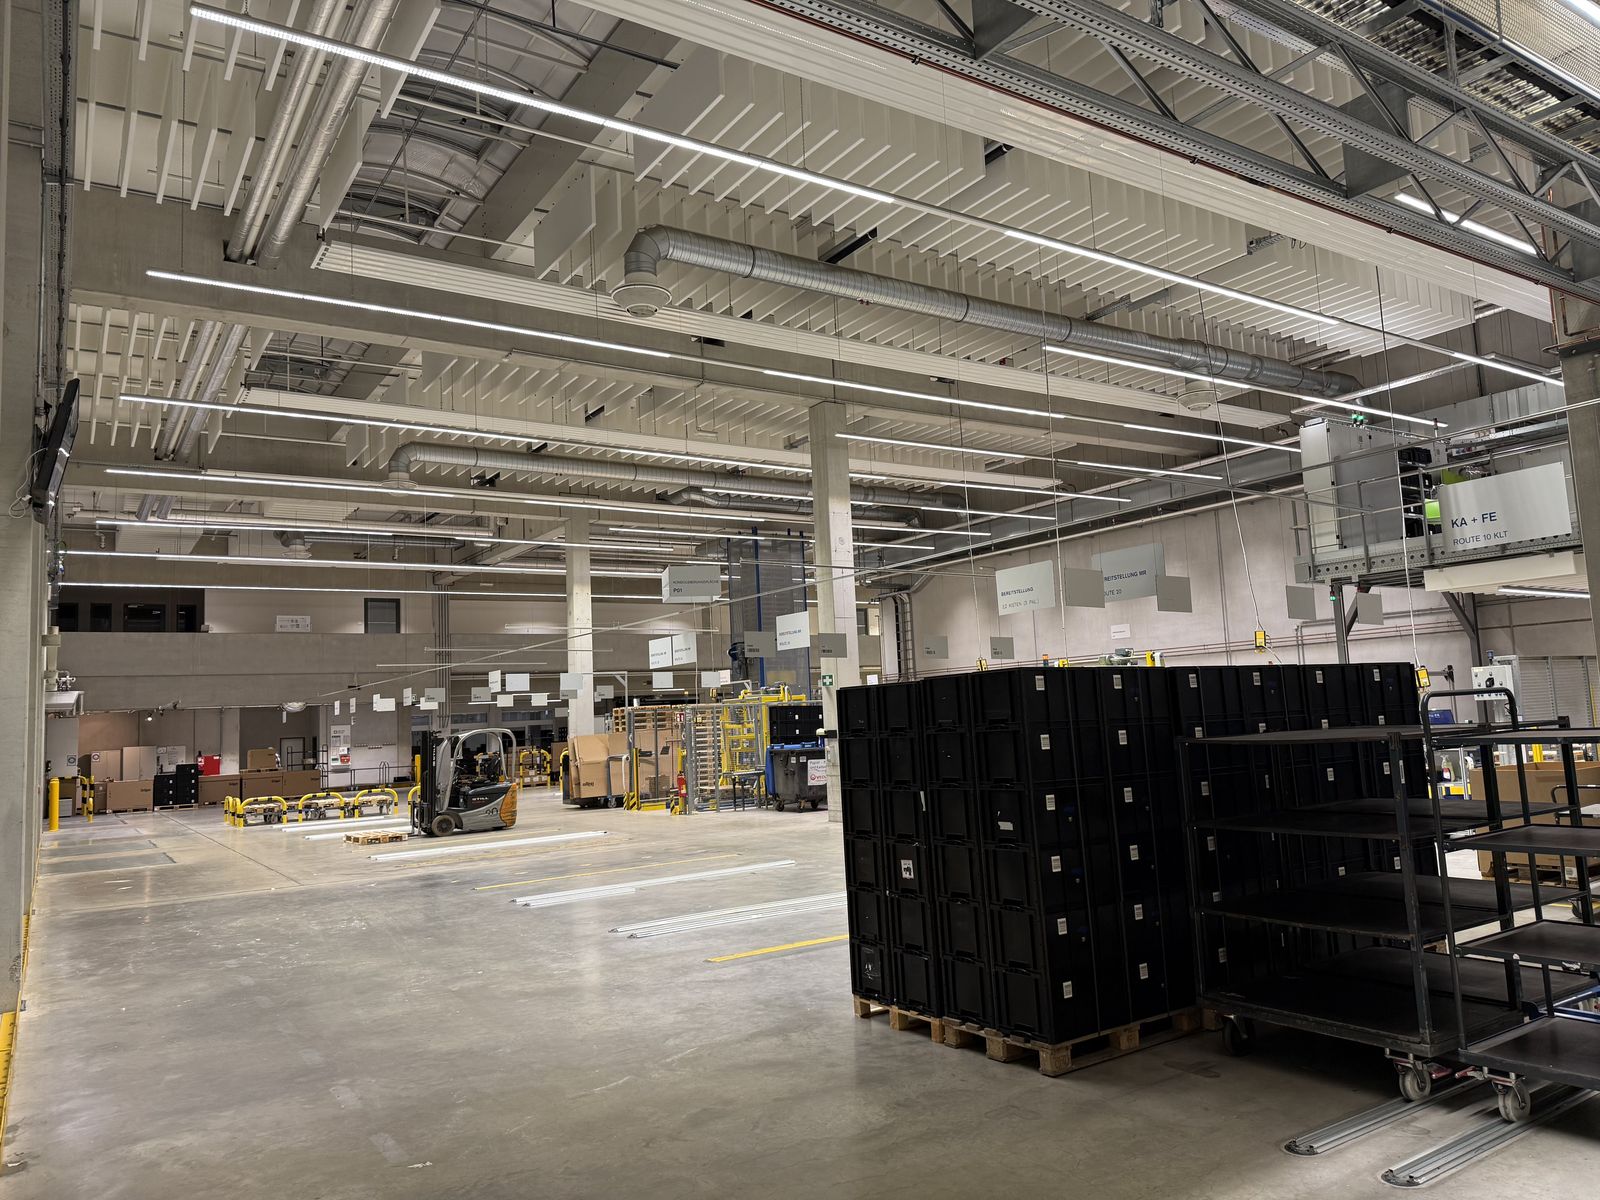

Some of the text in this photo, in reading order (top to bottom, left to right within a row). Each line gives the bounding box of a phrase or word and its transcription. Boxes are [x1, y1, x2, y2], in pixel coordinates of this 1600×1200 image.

[1451, 517, 1468, 528] KA
[1481, 511, 1498, 523] FE
[1453, 530, 1508, 546] ROUTE 10 KLT
[1104, 571, 1138, 582] REITSTELLUNG
[1104, 589, 1115, 597] OUTE
